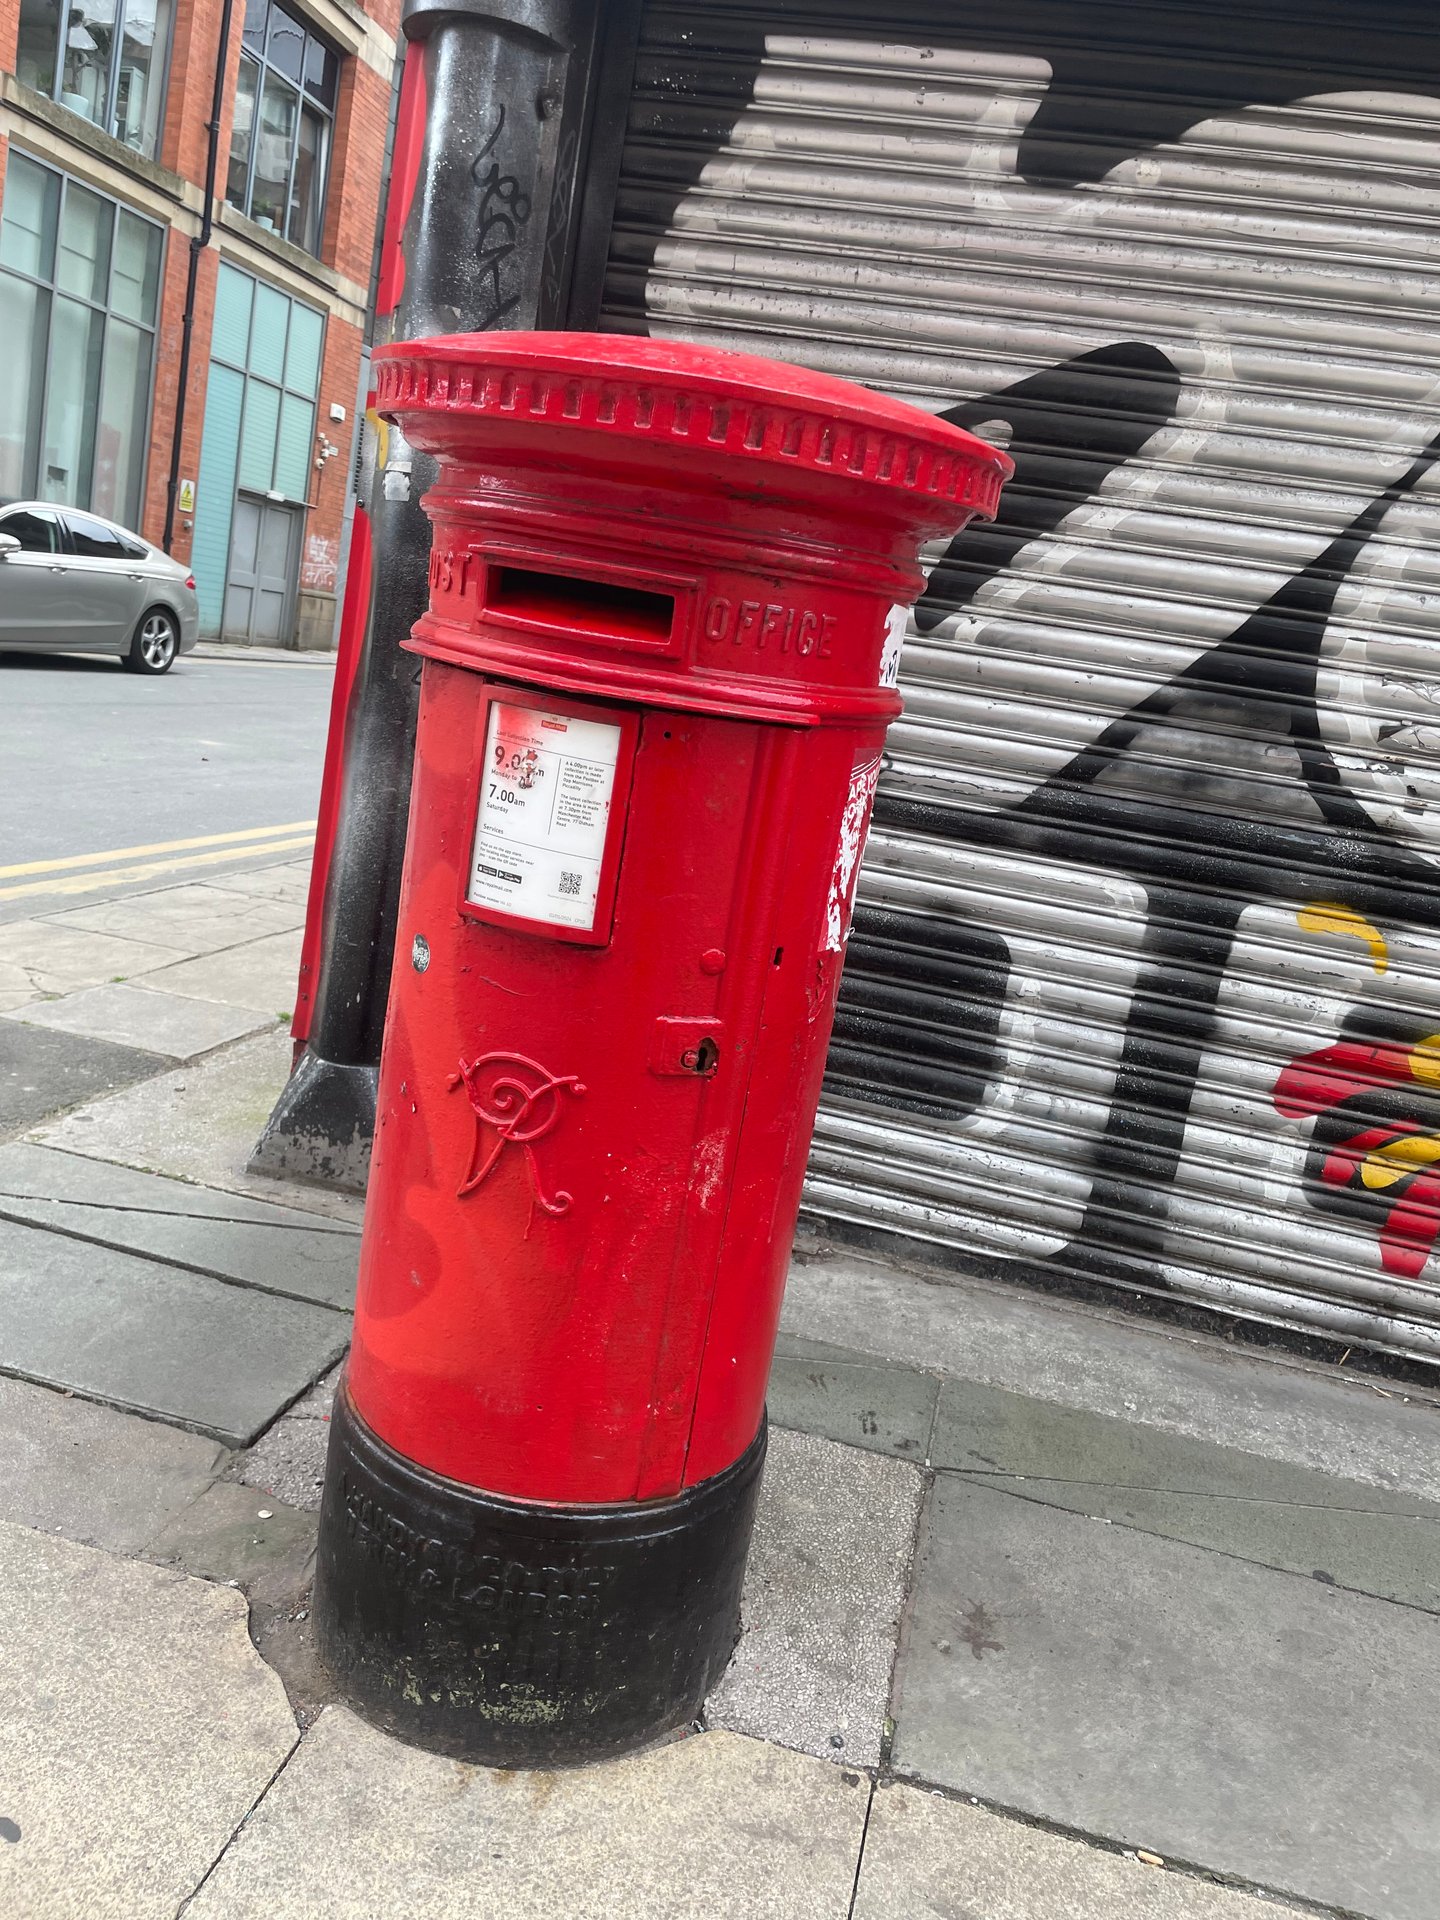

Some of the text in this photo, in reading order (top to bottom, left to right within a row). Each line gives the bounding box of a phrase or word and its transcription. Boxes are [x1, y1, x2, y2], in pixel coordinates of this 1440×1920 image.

[706, 597, 838, 659] OFFICE
[531, 737, 544, 746] Time
[491, 769, 511, 780] Monday
[489, 783, 526, 807] 7.00am
[486, 801, 508, 814] Saturday
[483, 823, 504, 835] Services
